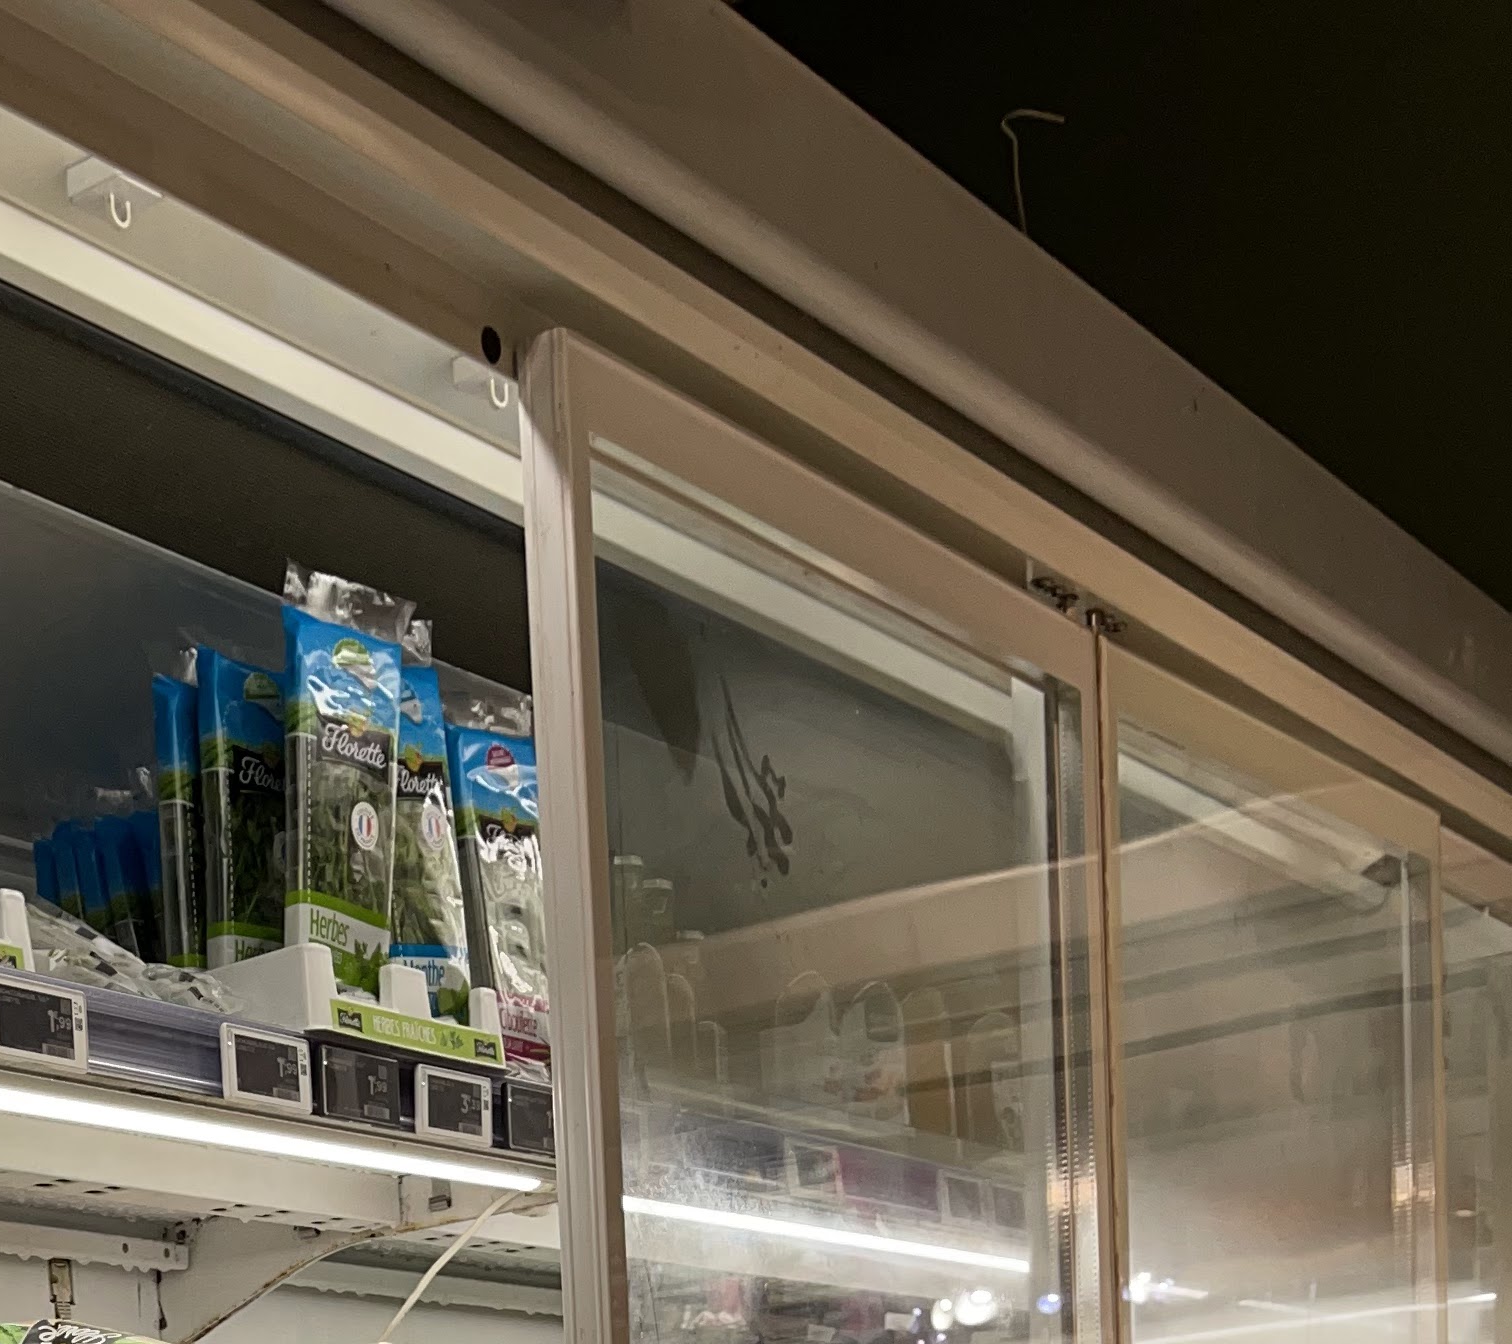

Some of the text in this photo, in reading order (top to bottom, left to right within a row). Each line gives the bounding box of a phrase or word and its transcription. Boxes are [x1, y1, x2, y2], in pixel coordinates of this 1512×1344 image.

[322, 723, 386, 769] Florette
[240, 756, 285, 788] Flore
[310, 908, 349, 946] Herbes
